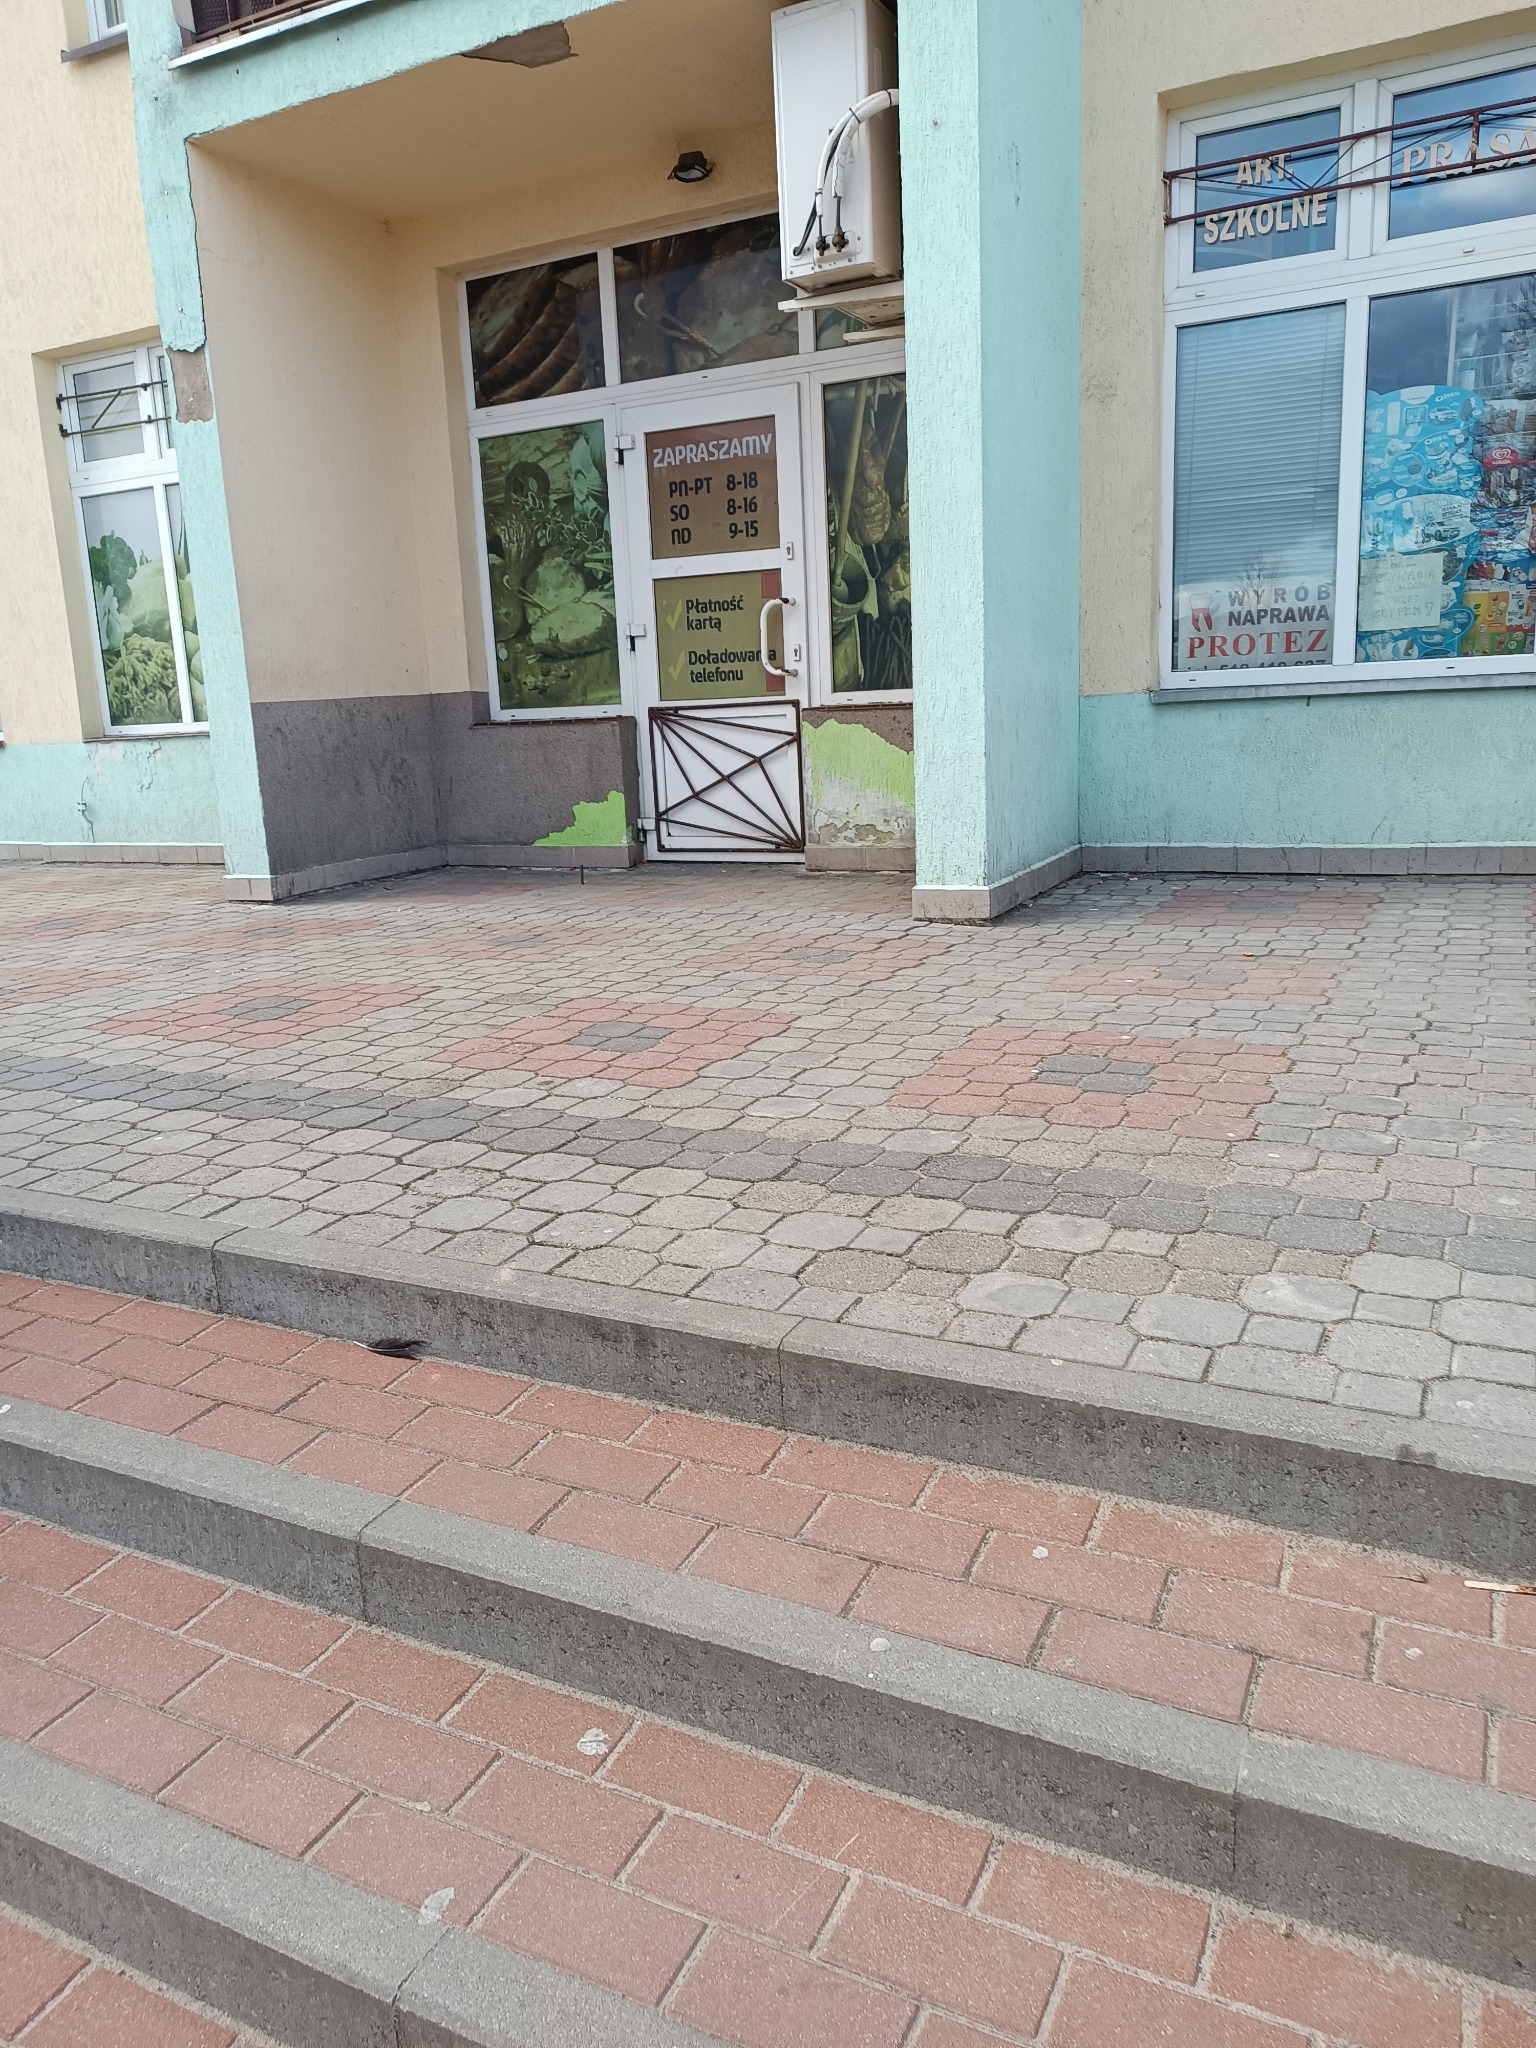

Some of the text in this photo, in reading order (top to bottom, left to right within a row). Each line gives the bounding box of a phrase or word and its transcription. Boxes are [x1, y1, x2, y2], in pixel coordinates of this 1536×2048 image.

[1235, 152, 1294, 188] ART.
[1203, 192, 1328, 244] SZKOLNE
[653, 433, 772, 468] ZAPRASZAMY
[726, 471, 758, 491] 8-18
[670, 496, 758, 521] SO 8-16
[671, 520, 759, 545] ND 9-15
[686, 594, 744, 614] Płatność
[1228, 582, 1331, 606] WYRÓB
[686, 615, 722, 632] kartą
[1228, 605, 1330, 626] NAPRAWA
[1186, 629, 1329, 659] PROTEZ
[688, 648, 777, 665] Doładowana
[690, 667, 744, 683] telefonu
